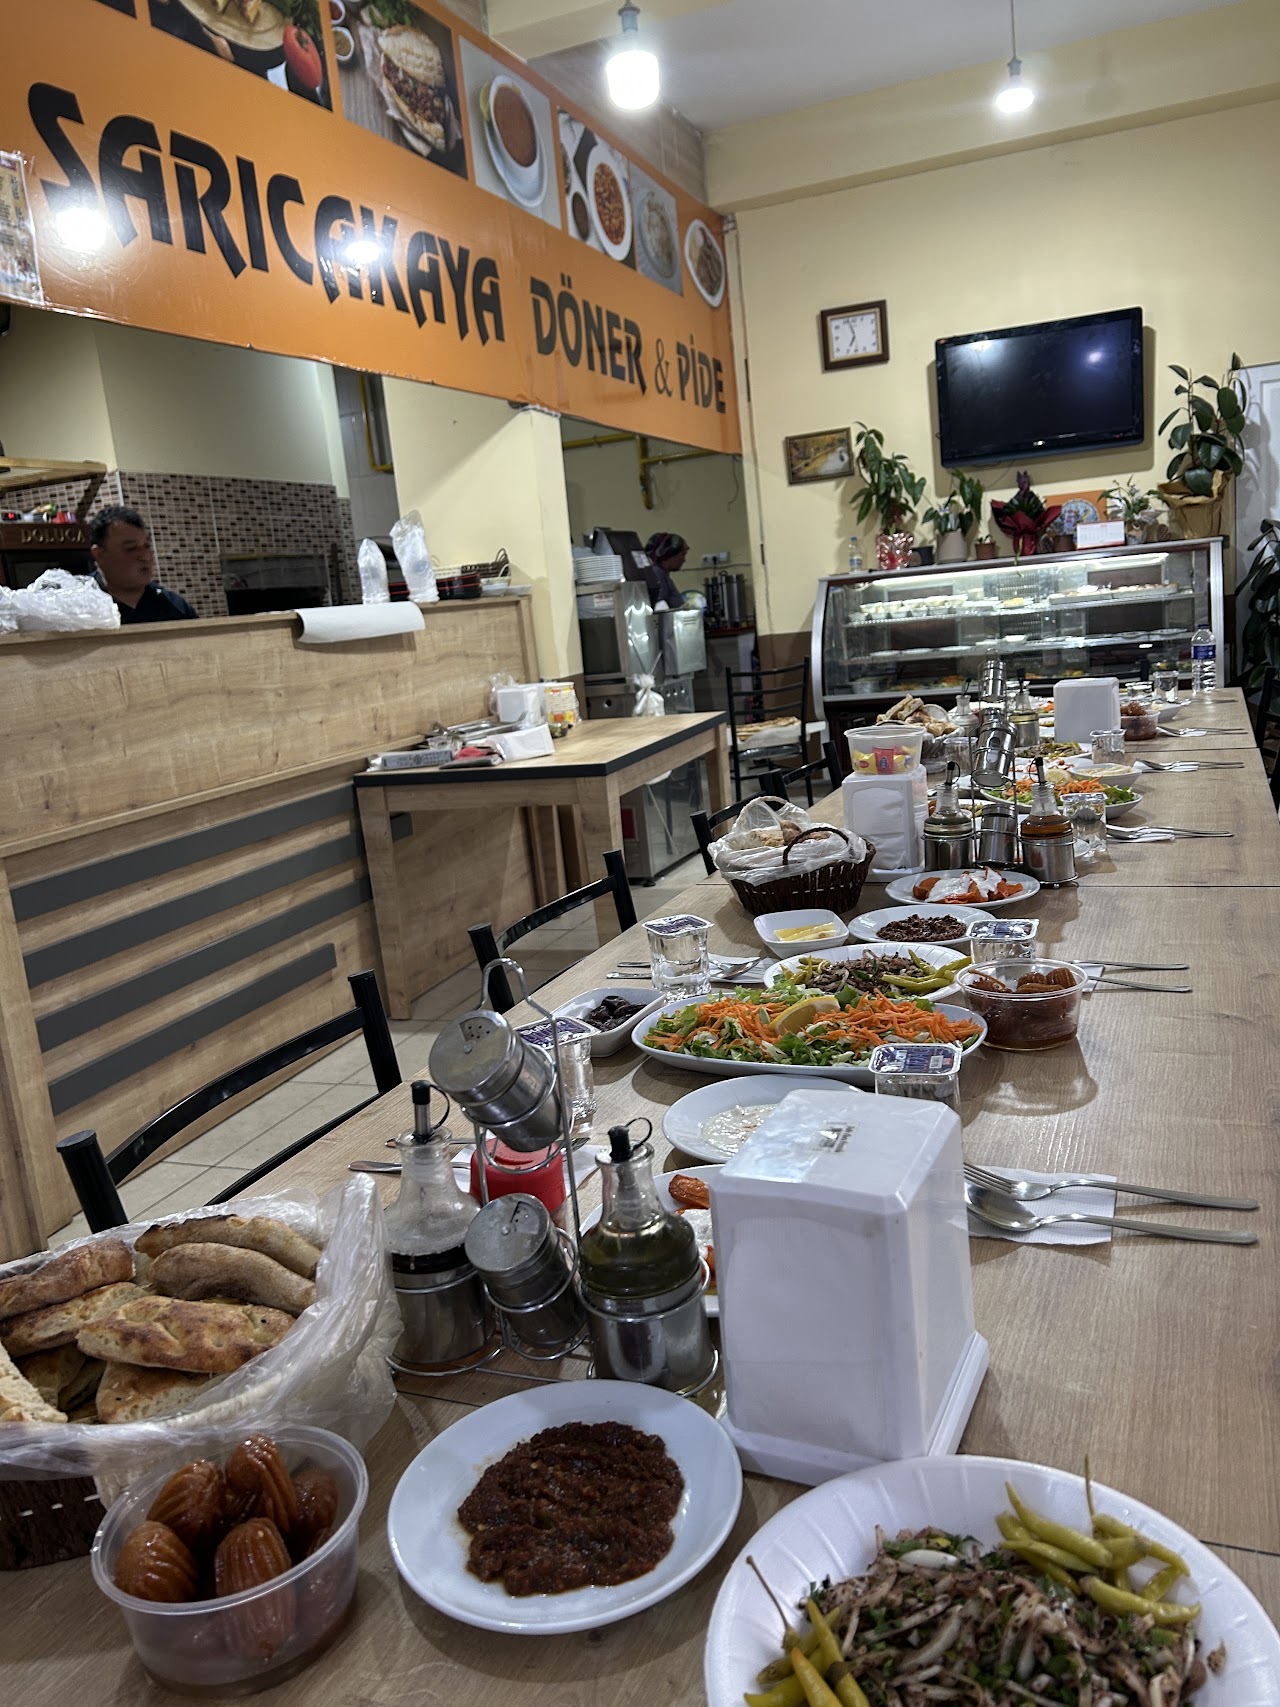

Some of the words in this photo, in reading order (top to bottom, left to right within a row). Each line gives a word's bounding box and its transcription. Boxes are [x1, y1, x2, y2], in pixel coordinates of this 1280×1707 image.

[28, 82, 505, 346] SARICAKAYA
[530, 272, 647, 395] DÖNER
[654, 338, 672, 397] &
[676, 333, 726, 414] PİDE
[21, 527, 86, 544] DOLUCA
